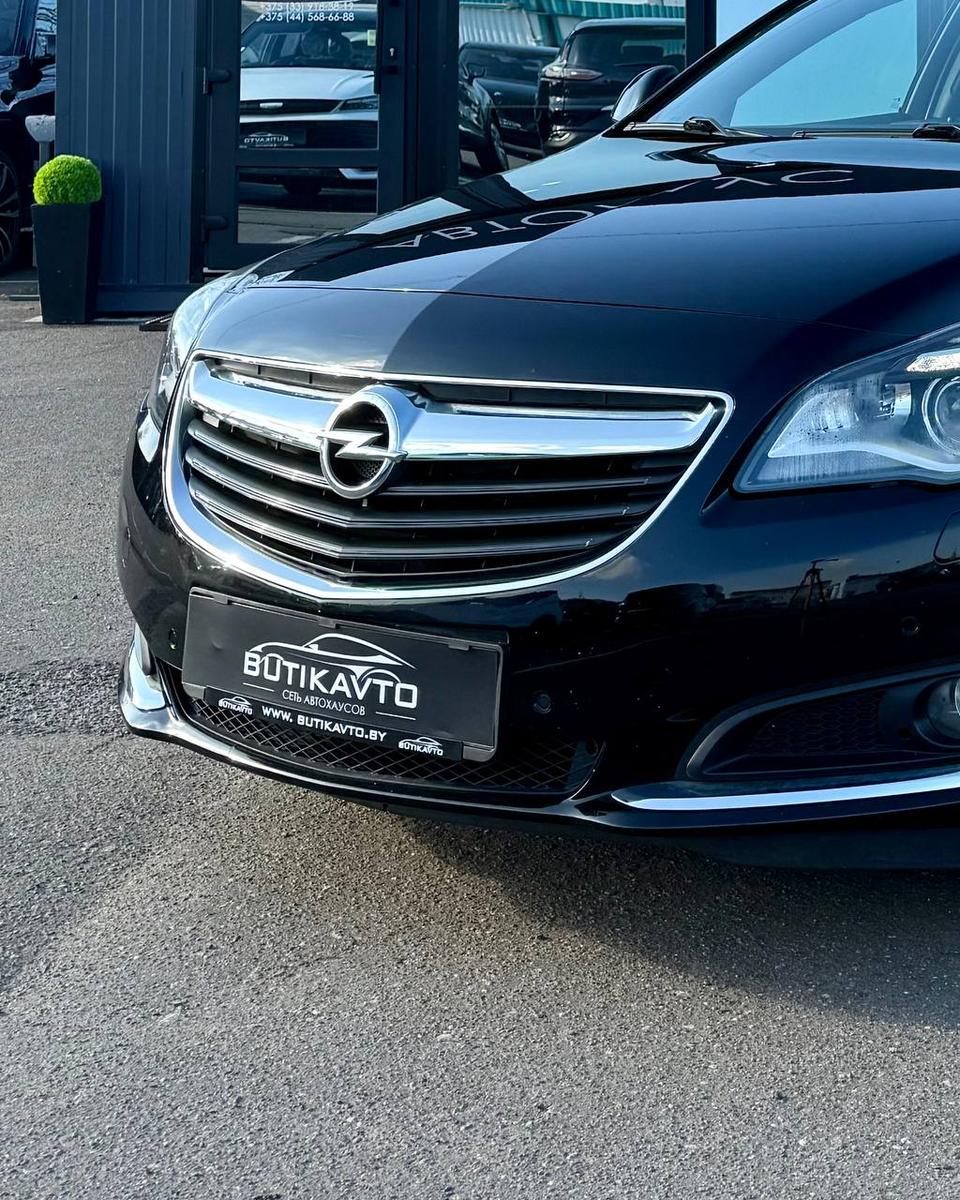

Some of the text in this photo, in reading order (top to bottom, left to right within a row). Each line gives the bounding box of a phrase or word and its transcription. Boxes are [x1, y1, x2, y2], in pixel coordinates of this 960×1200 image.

[259, 12, 355, 23] +375 (44) 568-66-88
[243, 651, 418, 709] BUTIKAVTO
[218, 699, 253, 714] BUTIKAVTO
[282, 689, 366, 716] СЕТЬ АВТОХАУСОВ
[398, 740, 443, 756] BUTIKAVTO
